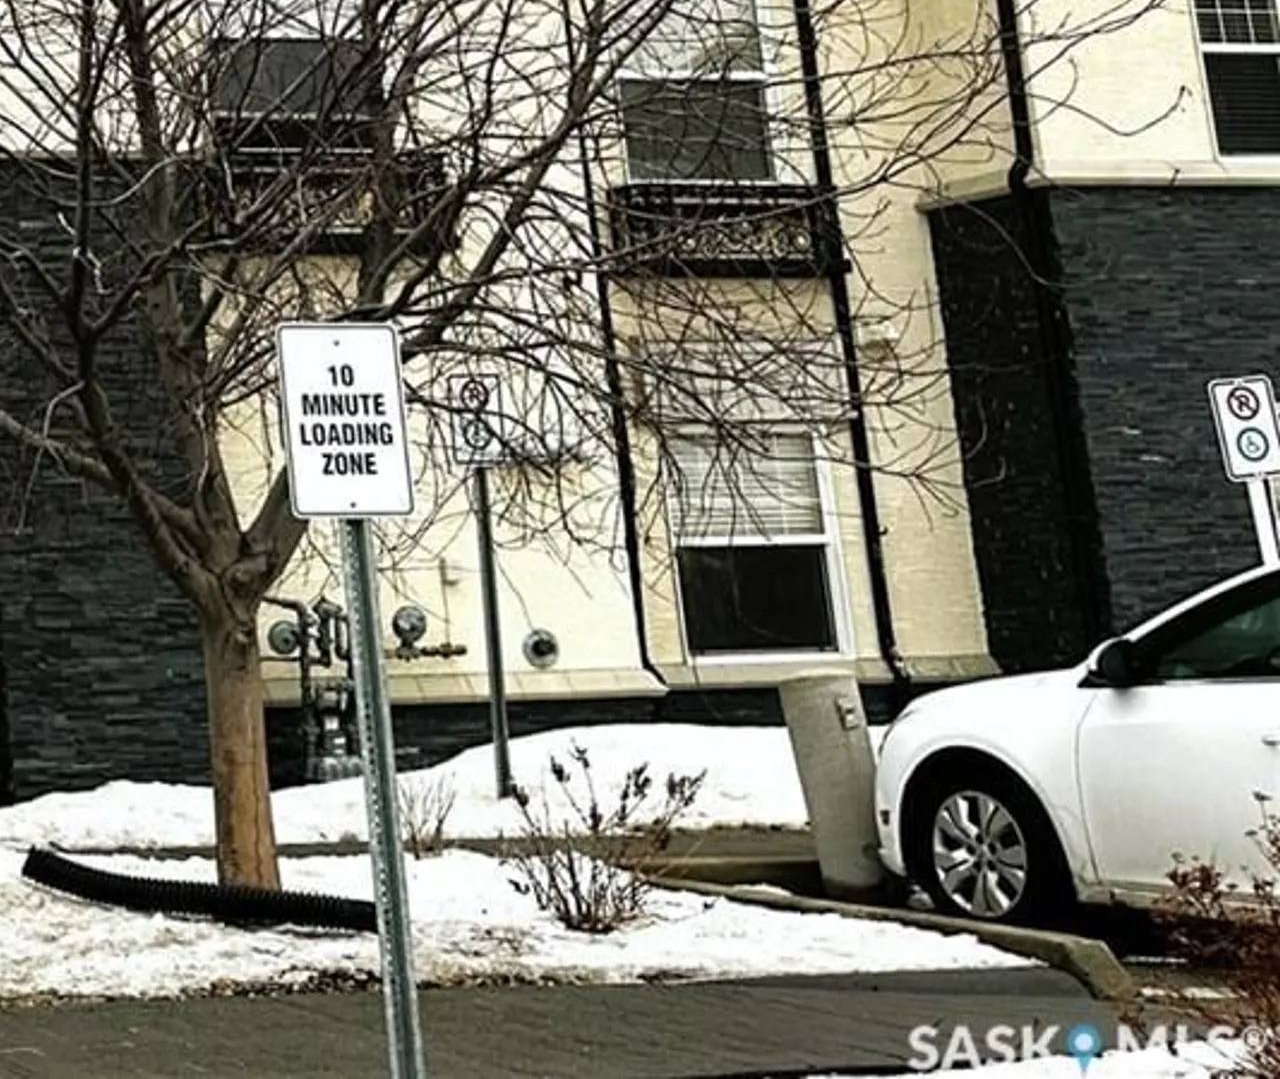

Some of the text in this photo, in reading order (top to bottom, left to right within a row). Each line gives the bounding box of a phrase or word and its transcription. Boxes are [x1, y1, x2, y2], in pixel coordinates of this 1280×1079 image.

[328, 364, 355, 387] 10
[302, 394, 386, 416] MINUTE
[300, 423, 394, 446] LOADING
[321, 452, 378, 475] ZONE
